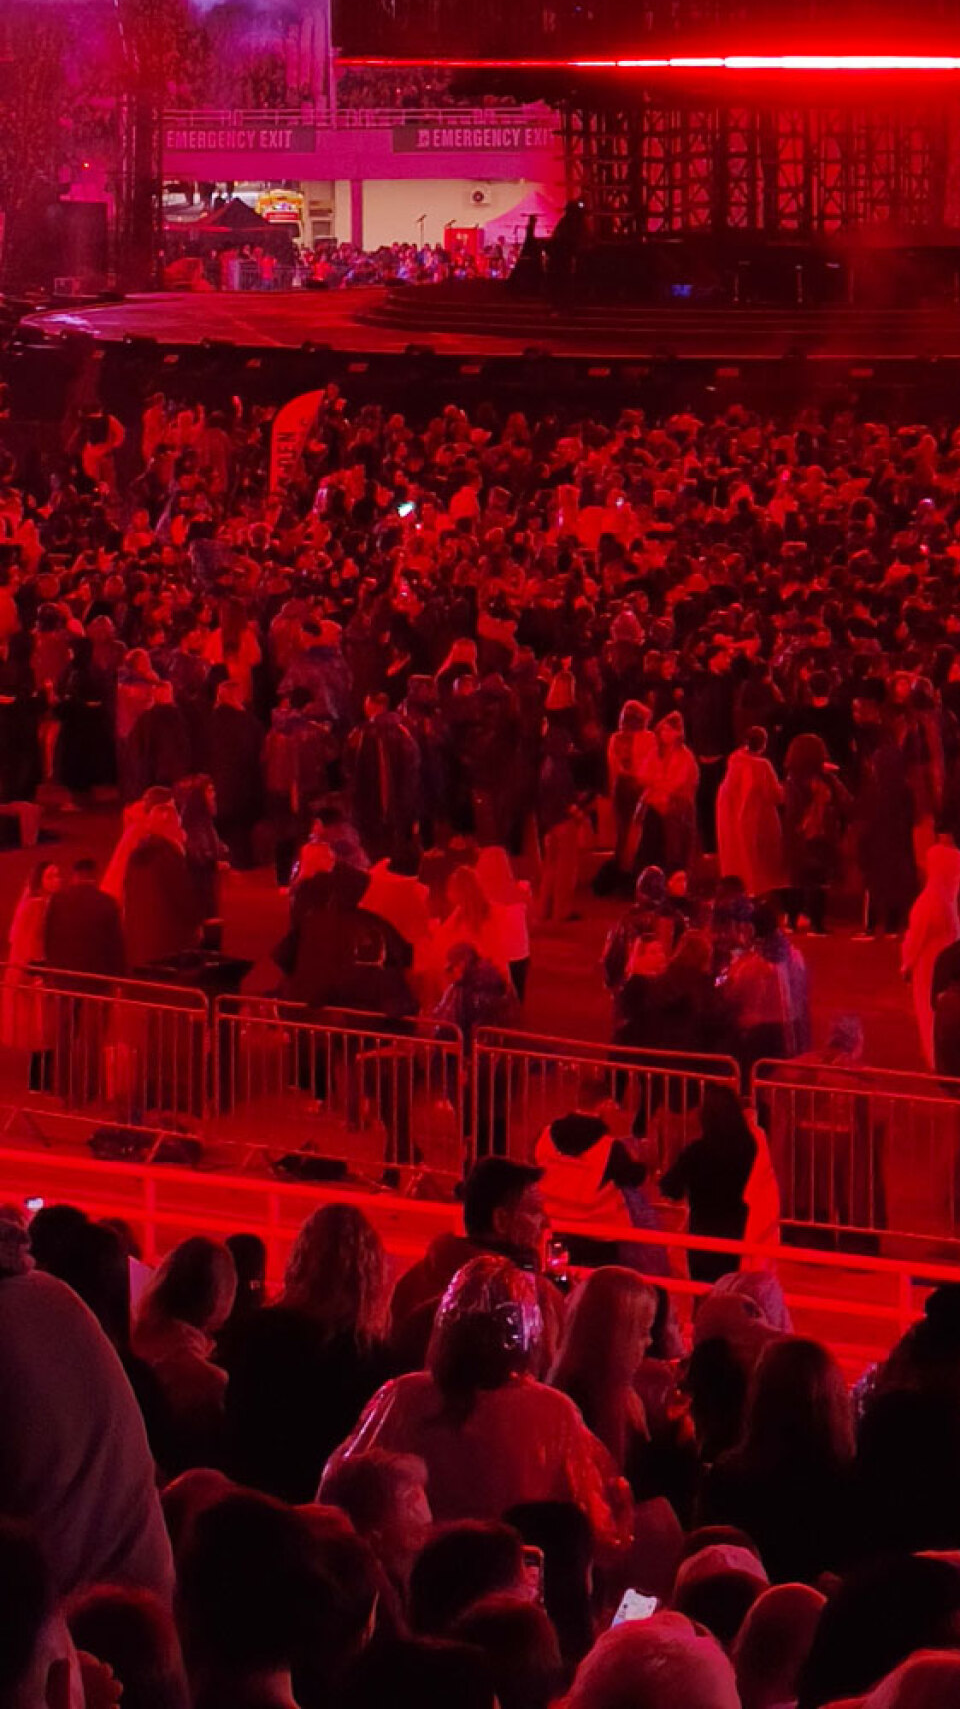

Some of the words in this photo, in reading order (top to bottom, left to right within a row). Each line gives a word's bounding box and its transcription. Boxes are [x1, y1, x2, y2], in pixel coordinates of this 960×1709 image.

[166, 130, 255, 149] EMERGENCY
[259, 130, 292, 149] EXIT
[433, 128, 520, 148] EMERGENCY
